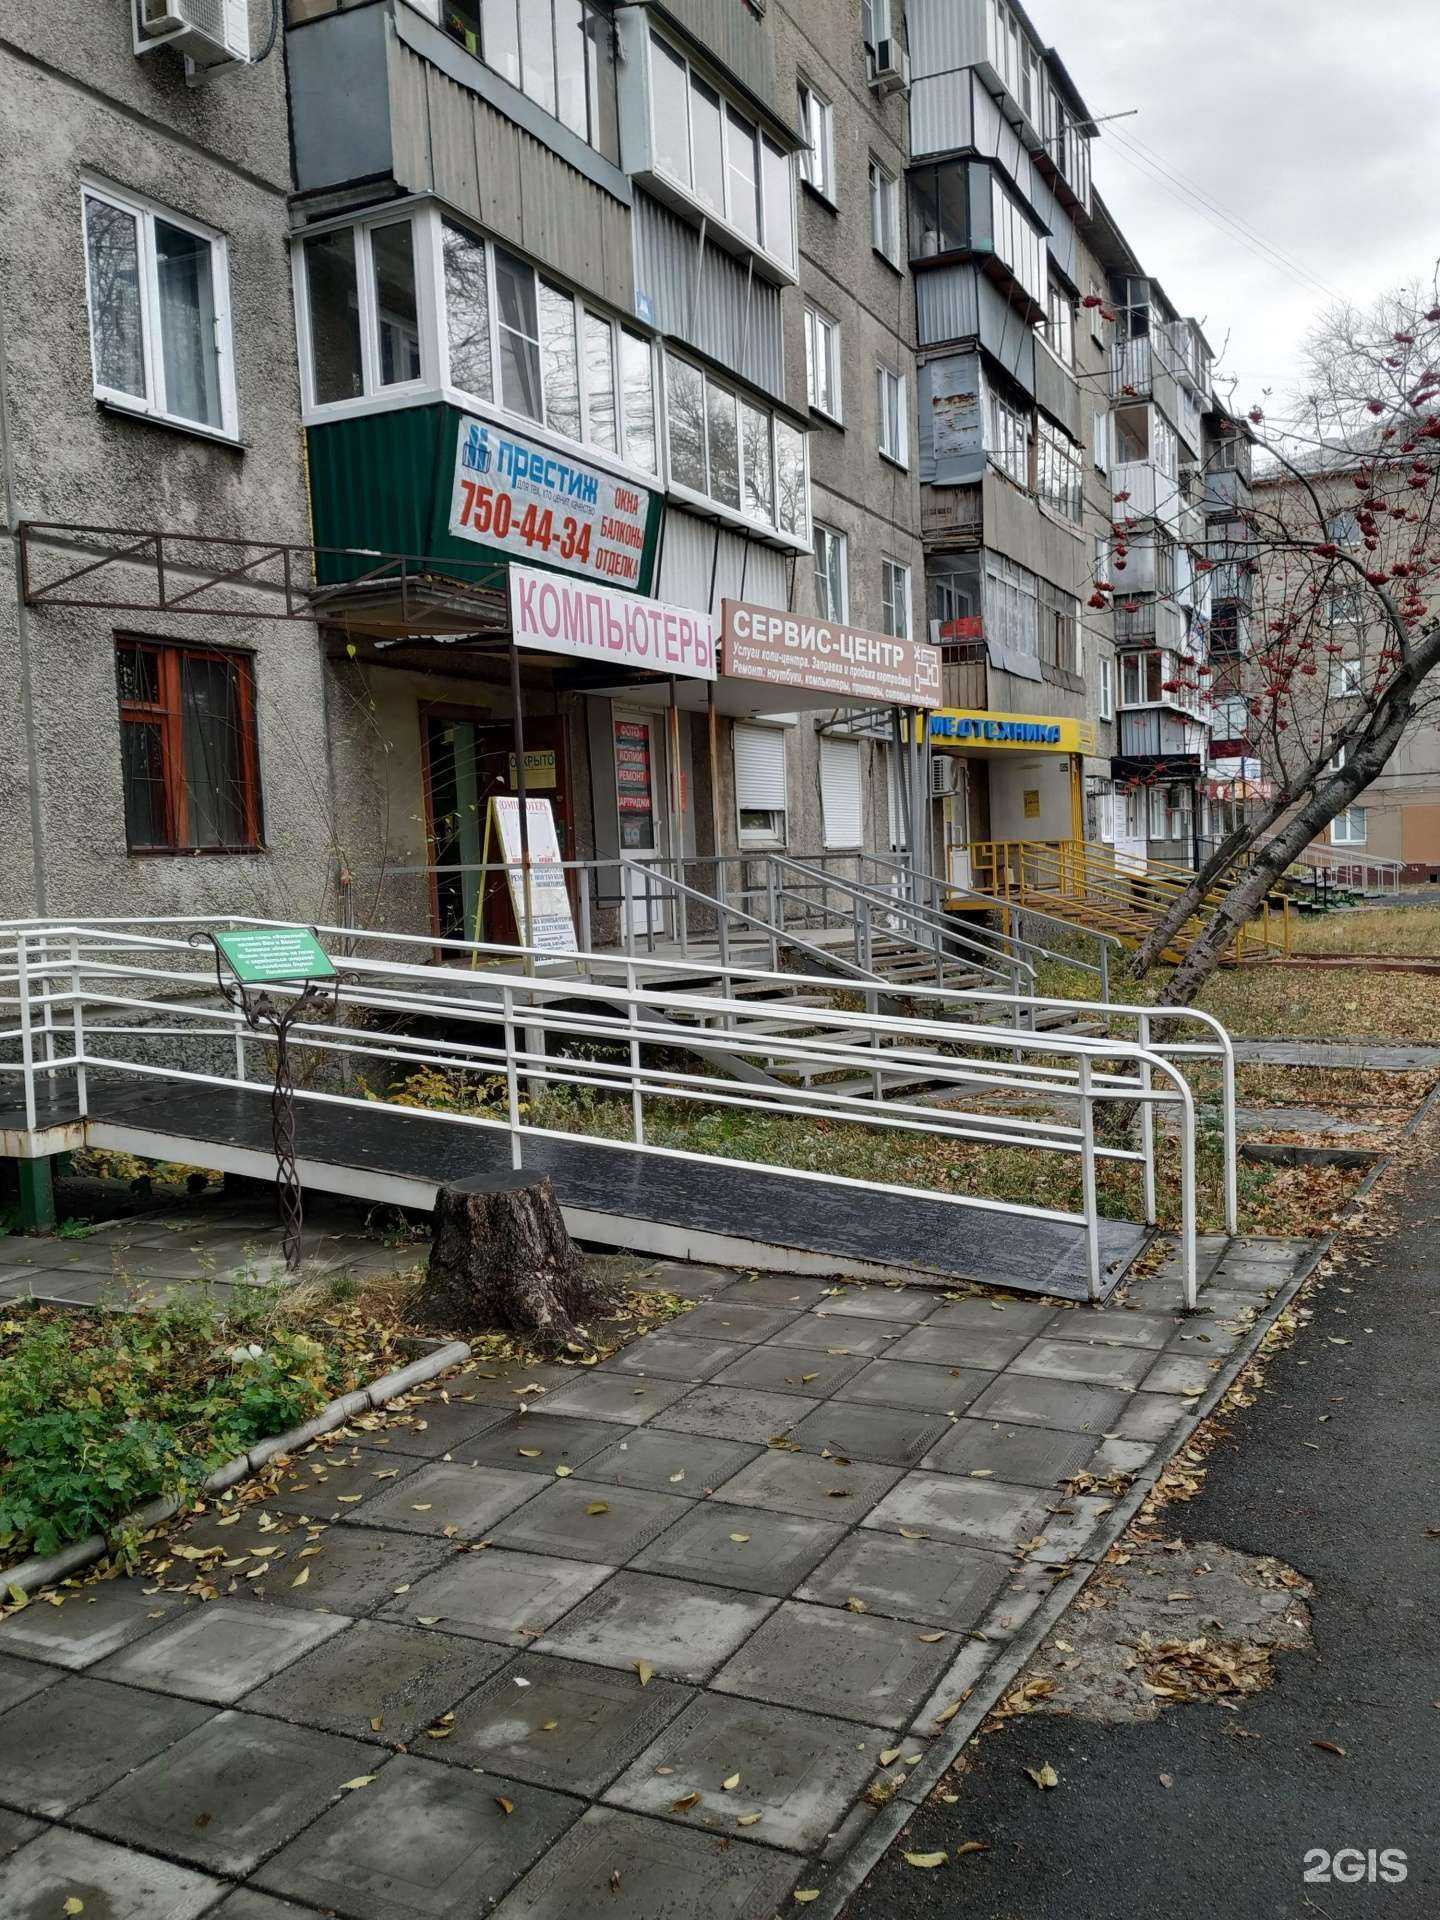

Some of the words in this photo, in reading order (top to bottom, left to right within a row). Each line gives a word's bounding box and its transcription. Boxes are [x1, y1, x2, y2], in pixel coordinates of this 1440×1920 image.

[614, 487, 639, 515] ОКНА
[460, 479, 592, 564] 750-44-34
[600, 515, 645, 548] БАЛКОНЫ
[595, 547, 638, 580] ОТДЕЛКА
[518, 577, 713, 668] КОМПЬЮТЕРЫ
[733, 609, 904, 668] СЕРВИС-ЦЕНТР
[733, 641, 760, 660] Услуги
[929, 715, 1061, 744] МЕДТЕХНИКА
[510, 754, 555, 767] ОКРЫТО
